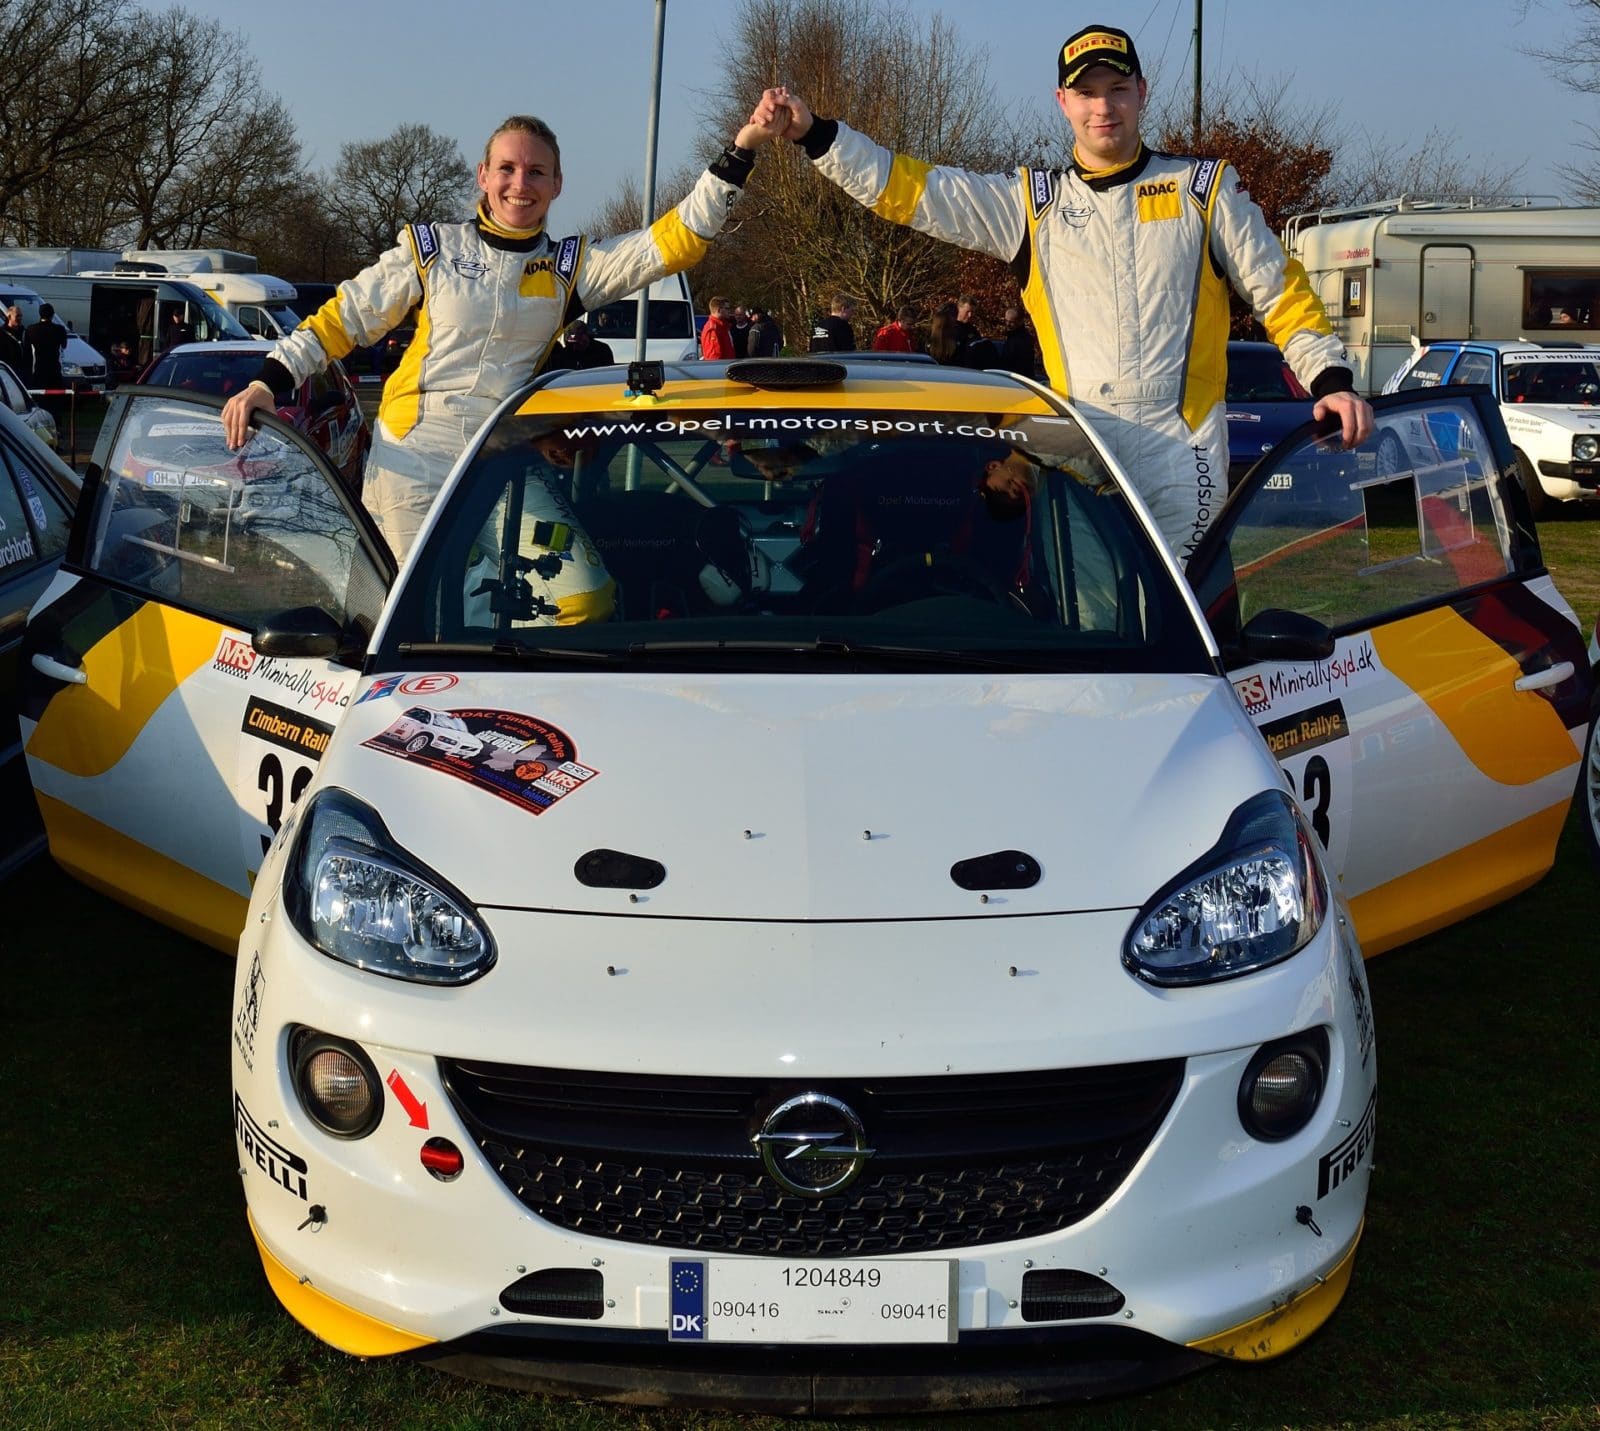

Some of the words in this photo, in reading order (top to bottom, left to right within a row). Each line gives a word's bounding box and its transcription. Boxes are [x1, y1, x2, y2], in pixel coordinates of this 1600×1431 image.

[1068, 36, 1122, 57] PIRELLI
[1034, 170, 1047, 203] sparco
[1138, 182, 1176, 198] ADAC
[1194, 160, 1213, 194] sparco
[417, 224, 433, 252] sparco
[523, 259, 553, 276] ADAC
[560, 239, 576, 272] sparco
[563, 414, 1028, 442] www.opel-motorsport.com
[1181, 445, 1213, 561] Motorsport
[218, 639, 257, 671] MRS
[1269, 640, 1376, 700] Minirallysyd.dk
[249, 707, 300, 742] Cimbern
[301, 728, 330, 753] Rall
[450, 711, 496, 720] ADAC
[497, 713, 547, 734] Cimbern
[545, 731, 566, 760] Rallye
[1267, 726, 1299, 753] bern
[1301, 713, 1341, 742] Rallye
[234, 1089, 308, 1202] PIRELLI
[781, 1267, 881, 1288] 1204849
[672, 1314, 702, 1332] DK
[712, 1301, 779, 1318] 090416
[880, 1304, 947, 1320] 090416
